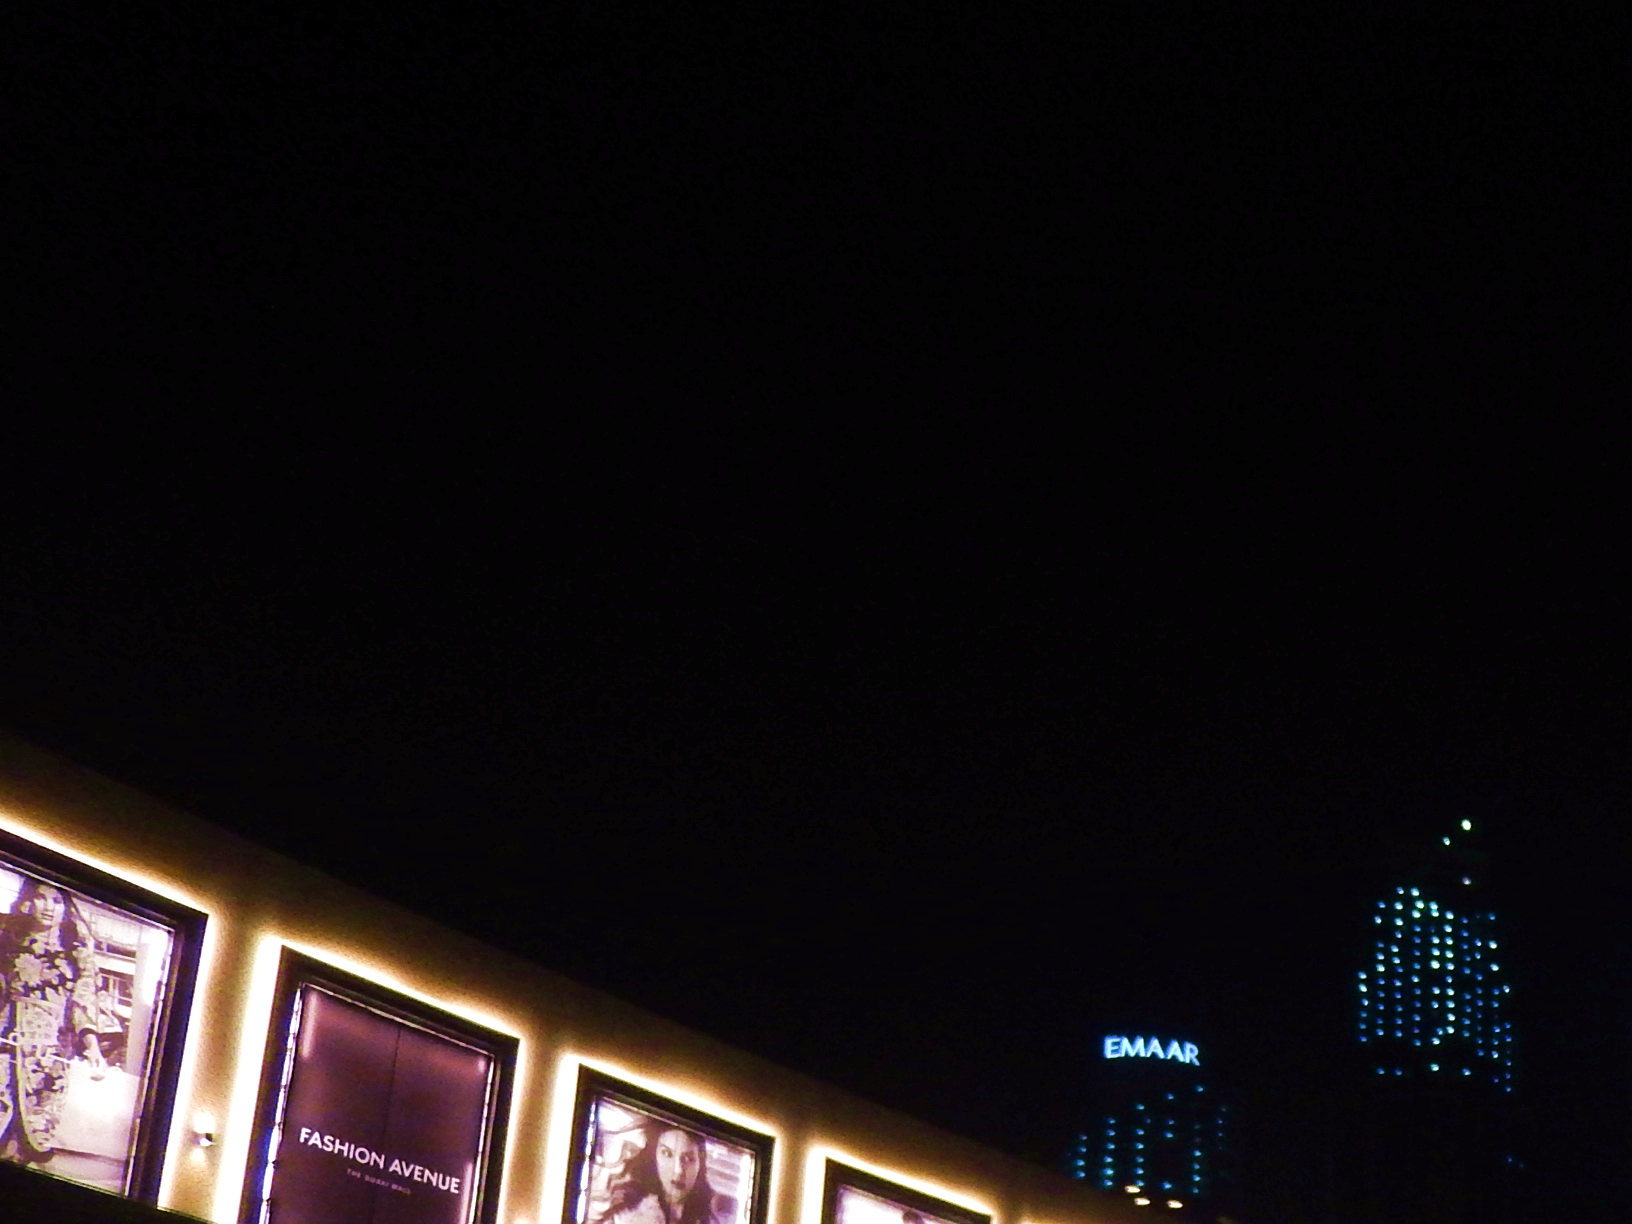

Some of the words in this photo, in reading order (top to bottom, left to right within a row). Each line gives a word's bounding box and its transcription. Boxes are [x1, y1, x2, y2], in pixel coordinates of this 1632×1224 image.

[1104, 1036, 1200, 1066] EMAAR
[299, 1127, 385, 1170] FASHION
[388, 1158, 460, 1194] AVENUE
